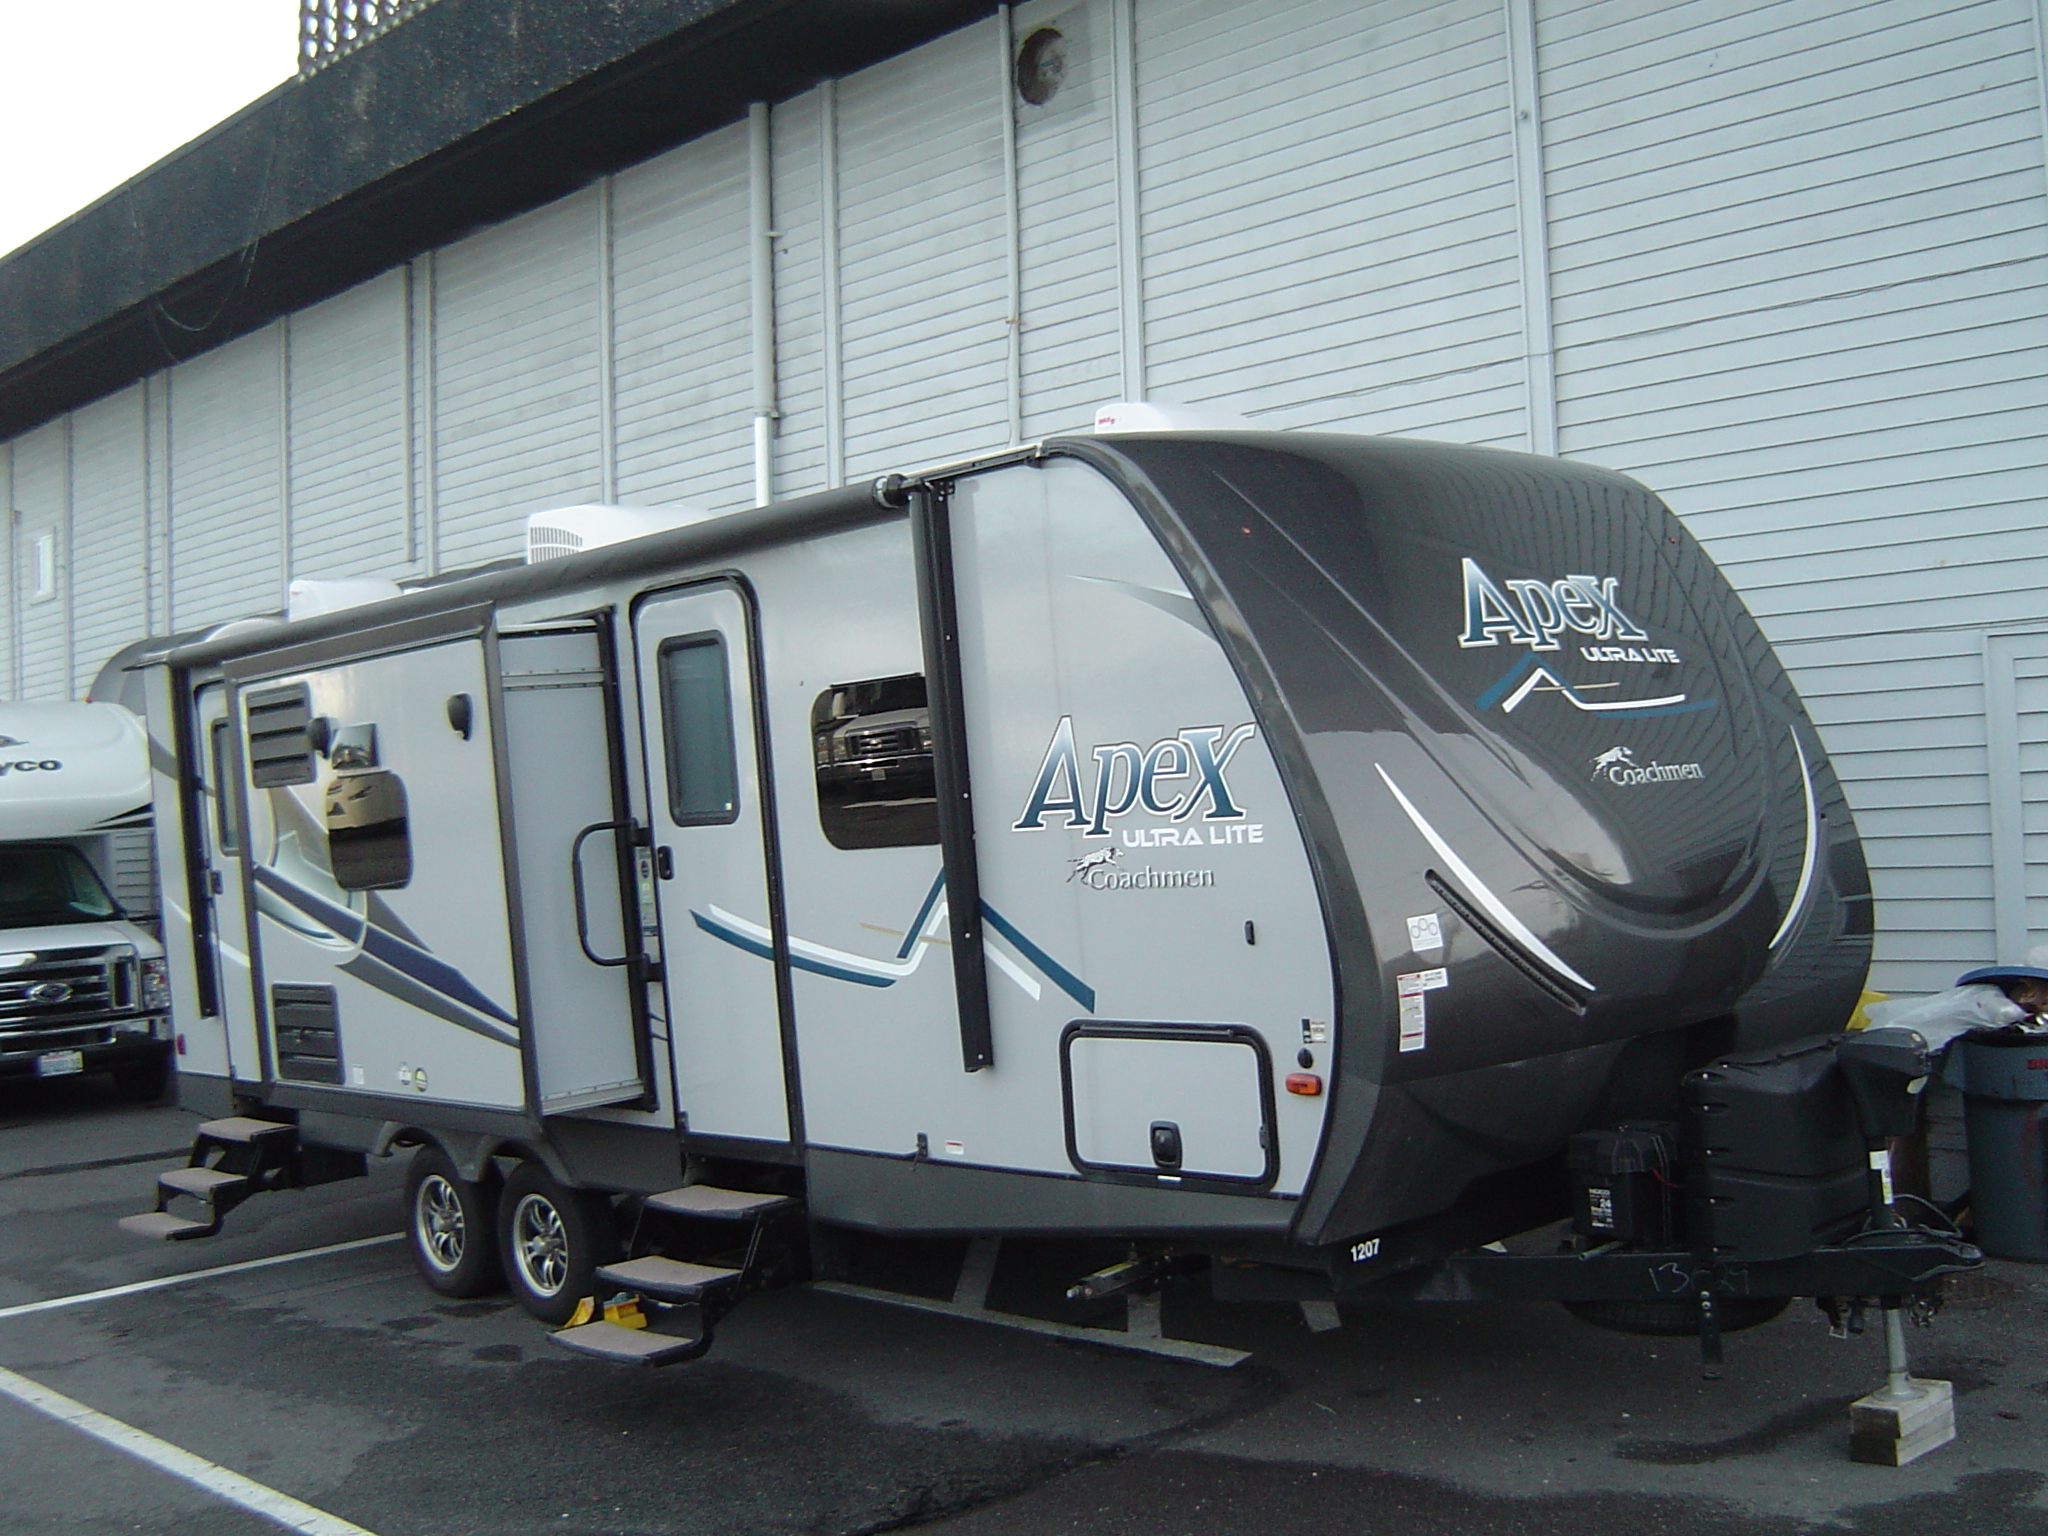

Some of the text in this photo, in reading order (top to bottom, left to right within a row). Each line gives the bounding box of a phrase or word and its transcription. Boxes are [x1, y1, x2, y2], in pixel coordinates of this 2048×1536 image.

[1580, 647, 1681, 664] ULTRA LITE
[1608, 760, 1704, 786] Coachmen
[1122, 823, 1264, 848] ULTRA LITE
[1087, 865, 1216, 890] Coachmen
[1350, 1238, 1380, 1262] 1207
